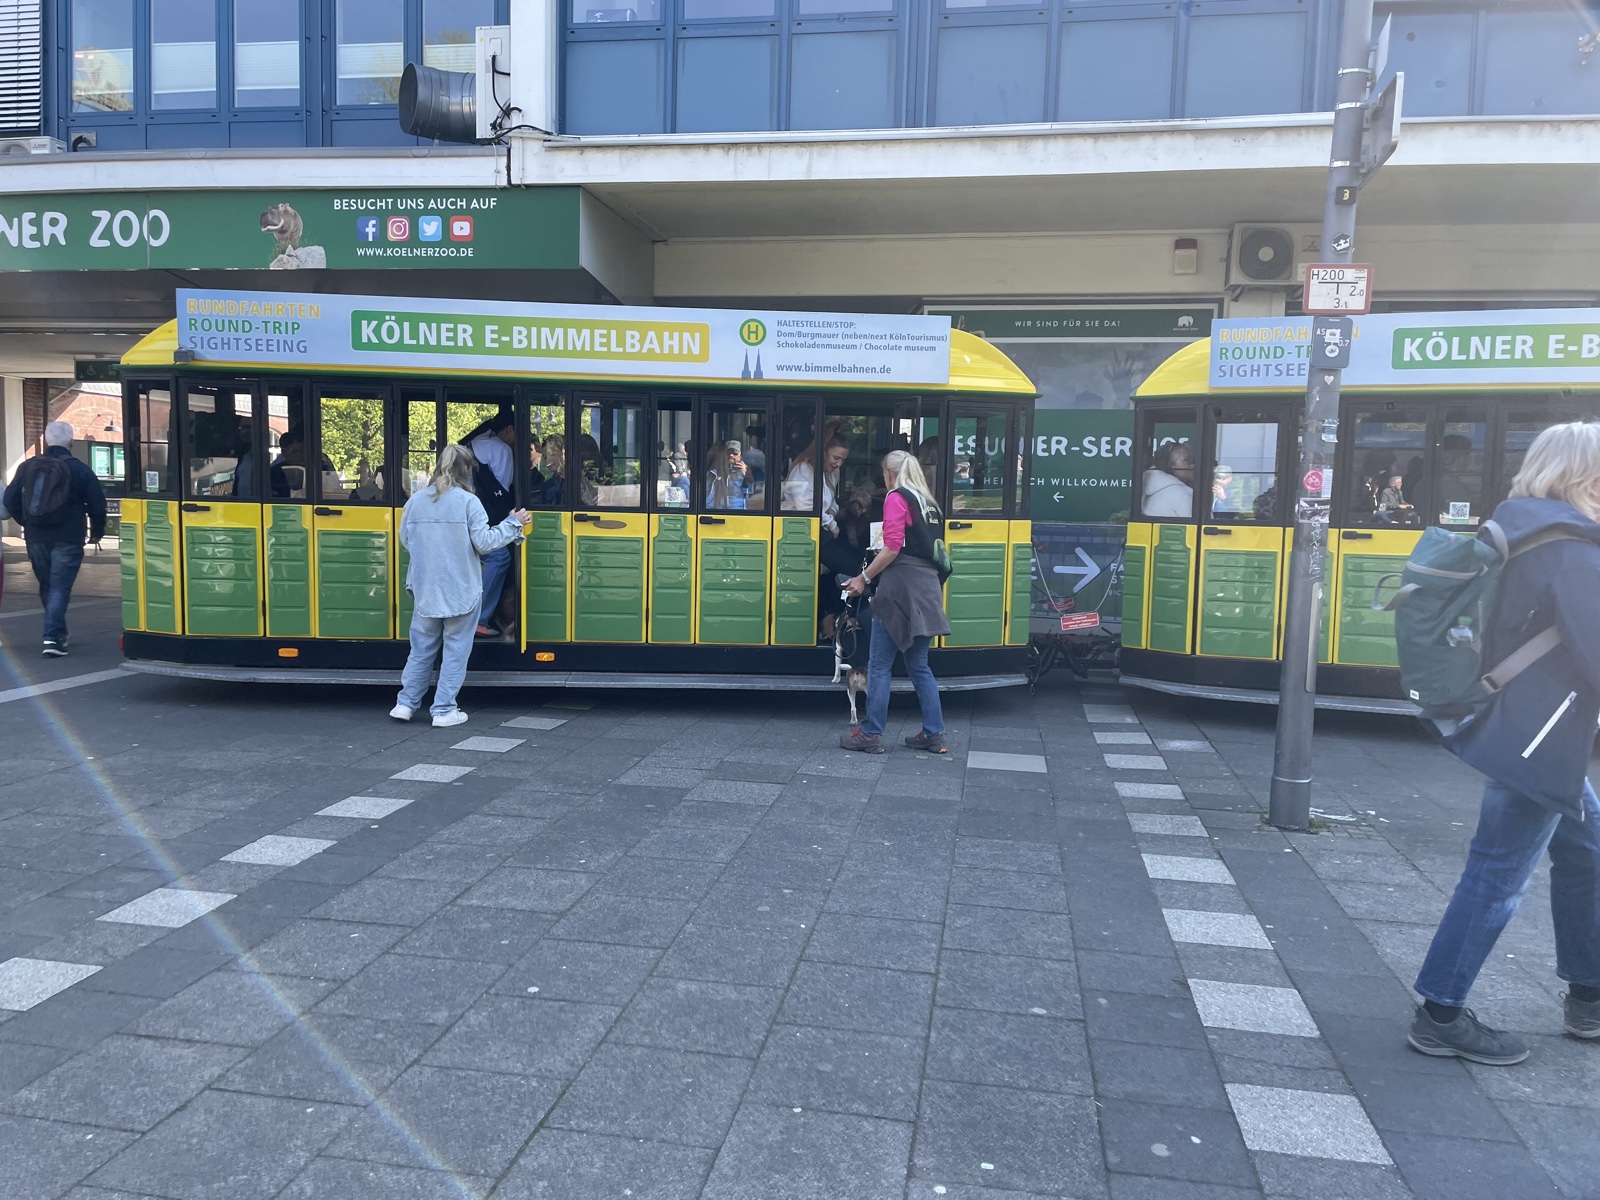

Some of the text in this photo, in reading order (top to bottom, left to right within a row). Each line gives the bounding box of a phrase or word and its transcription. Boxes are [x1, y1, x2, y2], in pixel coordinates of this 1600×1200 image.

[334, 198, 497, 210] BESUCHT UNS AUCH AUF
[89, 209, 170, 247] ZOO
[356, 247, 474, 257] WWW.KOELNERZOO.DE
[1312, 270, 1345, 280] H200
[186, 298, 321, 319] RUNDFAHRTEN
[188, 318, 301, 335] ROUND-TRIP
[777, 319, 856, 329] HALTESTELLEN/STOP:
[1063, 319, 1081, 327] FÜR
[360, 315, 700, 355] KÖLNER E-BIMMELBAHN
[777, 330, 947, 343] Dom/Burgmauer (neben/next KölnTourismus)
[188, 335, 308, 354] SIGHTSEEING
[777, 340, 857, 350] Schokoladenmuseum
[864, 343, 902, 351] Chocolate
[1403, 331, 1534, 361] KÖLNER
[776, 363, 892, 375] www.bimmelbahnen.de
[1218, 363, 1306, 378] SIGHTSEE
[1051, 478, 1132, 487] WILLKOMME
